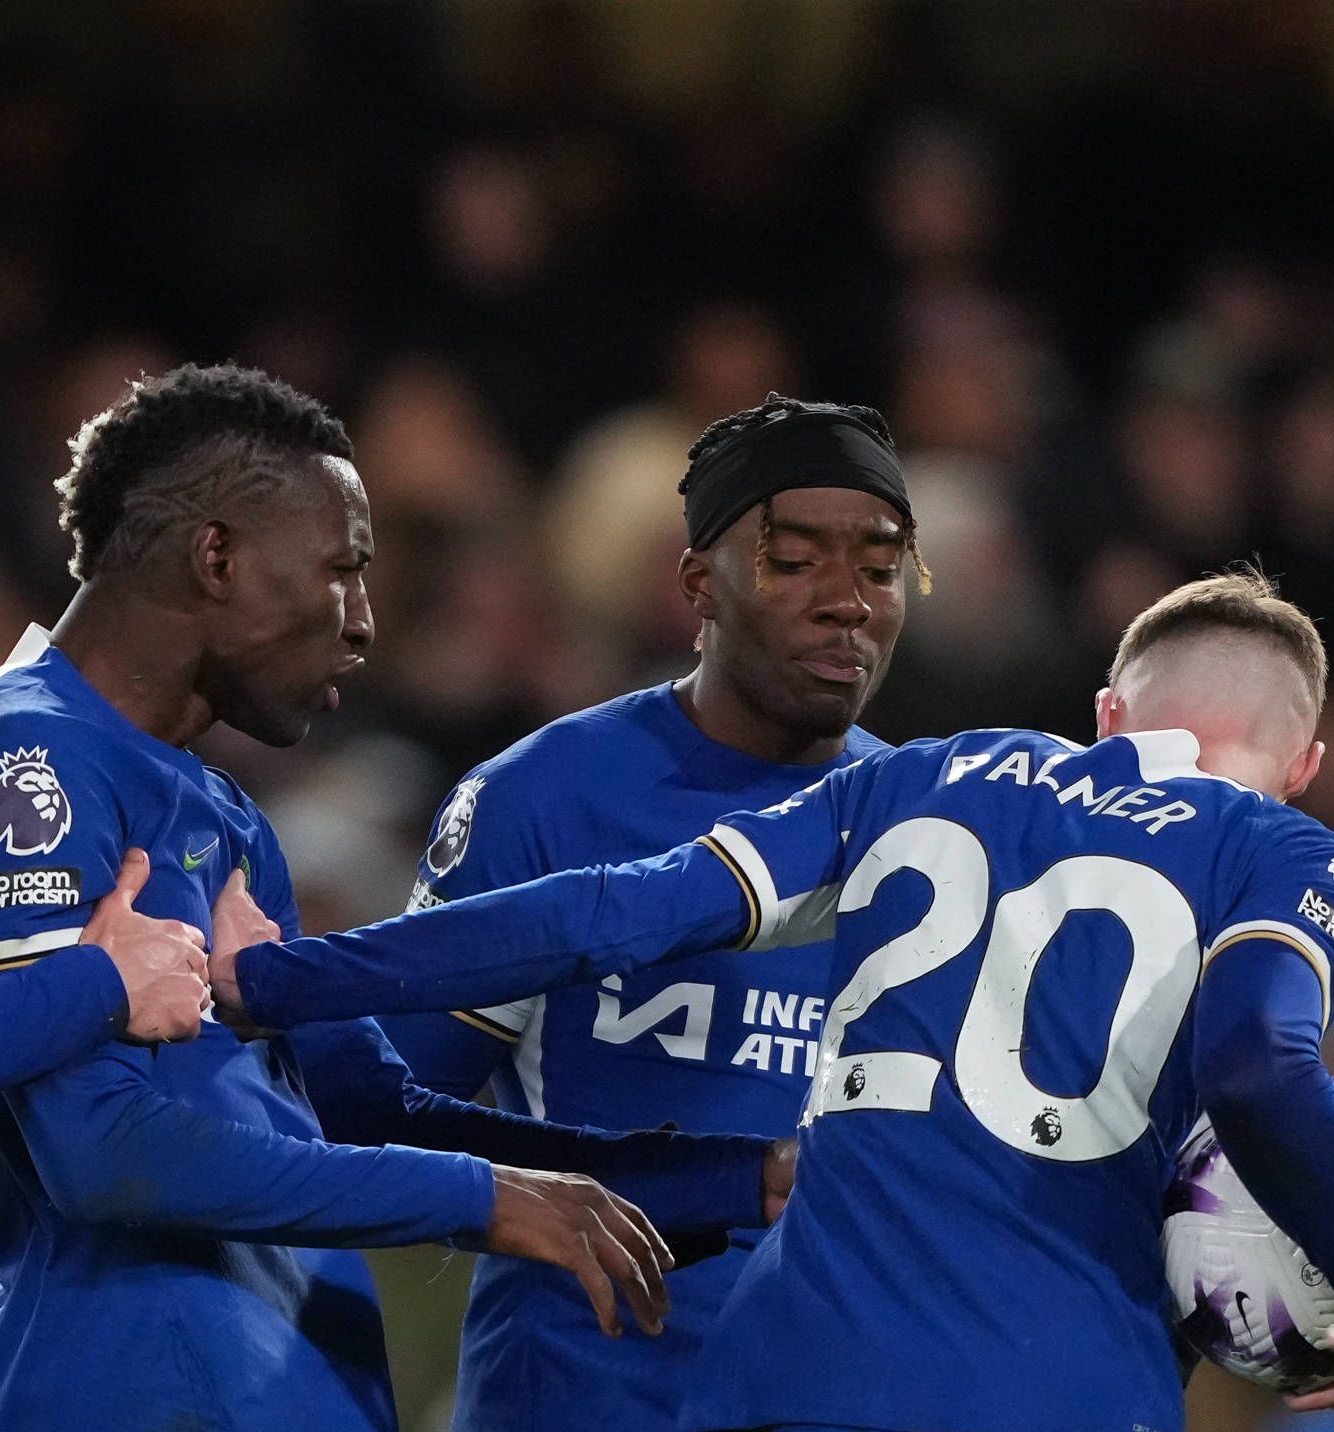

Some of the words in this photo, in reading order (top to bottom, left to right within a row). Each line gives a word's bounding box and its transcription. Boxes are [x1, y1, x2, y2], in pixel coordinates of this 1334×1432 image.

[946, 751, 1197, 836] PALMER
[11, 888, 79, 906] racism
[13, 871, 71, 889] room
[1301, 888, 1331, 917] No
[798, 815, 1202, 1162] 20
[742, 988, 825, 1031] INF
